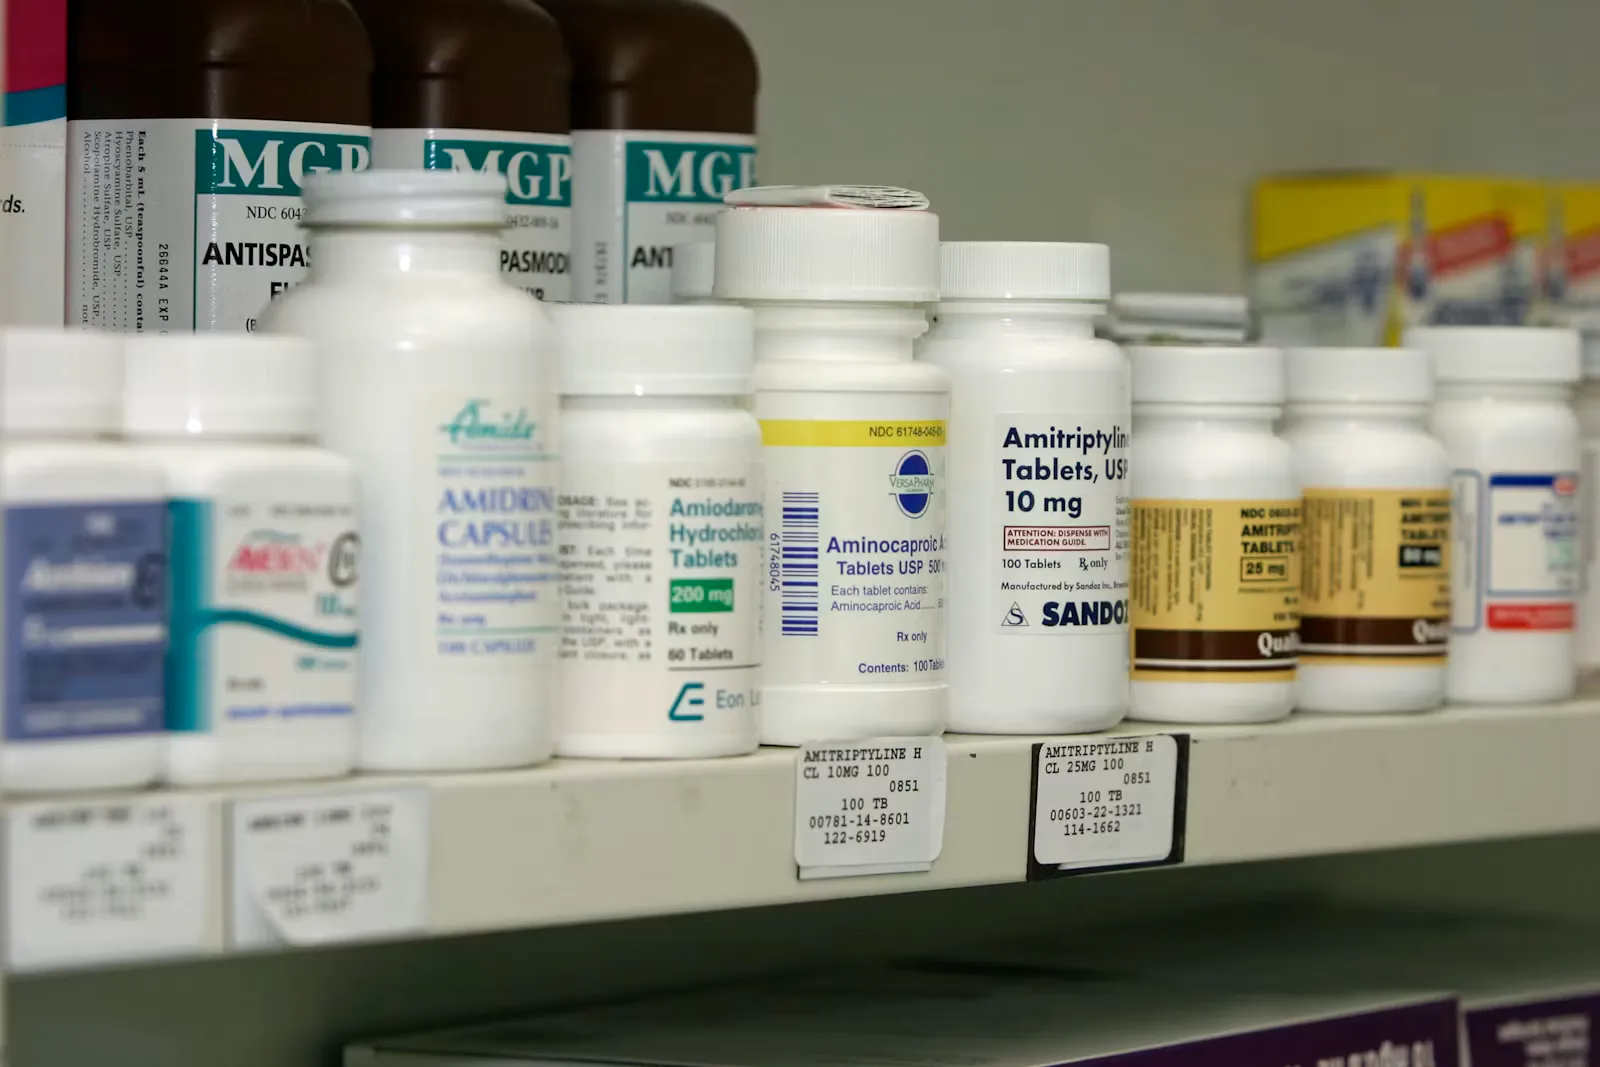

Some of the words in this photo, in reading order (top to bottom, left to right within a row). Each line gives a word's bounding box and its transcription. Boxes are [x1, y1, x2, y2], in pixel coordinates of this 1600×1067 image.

[138, 130, 146, 160] Each
[103, 131, 111, 180] Atropine
[215, 138, 370, 188] MGP
[138, 165, 145, 173] 5
[0, 194, 25, 213] ds.
[246, 206, 277, 220] NDC
[103, 229, 111, 250] USP
[135, 202, 145, 288] (teaspoonful)
[113, 255, 121, 276] USP
[158, 244, 169, 289] 26644A
[158, 298, 169, 322] EXP
[869, 427, 893, 437] NDC
[1002, 457, 1098, 483] Tablets,
[1105, 458, 1128, 480] USP
[1006, 490, 1035, 512] 10
[1044, 497, 1082, 519] mg
[1241, 508, 1265, 518] NDC
[1058, 529, 1092, 537] DISPENSE
[1093, 529, 1108, 537] WITH
[826, 536, 937, 557] Aminocaproic
[1007, 538, 1060, 546] MEDICATION
[1061, 538, 1087, 546] GUIDE.
[669, 549, 737, 568] Tablets
[769, 533, 781, 592] 61748045
[1002, 559, 1021, 569] 100
[1025, 558, 1061, 569] Tablets
[1090, 557, 1108, 570] only
[836, 561, 894, 576] Tablets
[899, 560, 923, 575] USP
[1246, 563, 1263, 574] 25
[1268, 564, 1285, 576] mg
[831, 585, 859, 596] Each
[863, 585, 891, 596] tablet
[894, 585, 928, 595] contains:
[1001, 582, 1062, 590] Manufactured
[1064, 582, 1073, 592] by
[1076, 581, 1100, 590] Sandoz
[671, 585, 704, 603] 200
[708, 589, 732, 607] mg
[831, 600, 902, 613] Aminocaproic
[668, 621, 686, 635] Rx
[690, 621, 718, 638] only
[897, 631, 909, 642] Rx
[912, 630, 927, 643] only
[690, 647, 733, 661] Tablets
[858, 663, 908, 674] Contents:
[914, 660, 927, 672] 100
[716, 689, 744, 709] Eon
[804, 748, 906, 762] AMITRIPTYLINE
[914, 748, 922, 759] H
[1045, 742, 1139, 758] AMITRIPTYLINE
[1146, 741, 1153, 752] H
[803, 767, 819, 779] CL
[828, 766, 859, 778] 10MG
[867, 765, 889, 777] 100
[1045, 763, 1060, 774] CL
[1067, 761, 1096, 773] 25MG
[1103, 758, 1124, 770] 100
[889, 780, 919, 792] 0851
[1123, 772, 1151, 785] 0851
[1080, 791, 1101, 803] 100
[1108, 790, 1122, 801] TB
[842, 798, 864, 811] 100
[873, 798, 888, 809] TB
[1050, 803, 1142, 821] 00603-22-1321
[809, 813, 909, 828] 00781-14-8601
[1064, 821, 1120, 836] 114-1662
[824, 830, 886, 844] 122-6919
